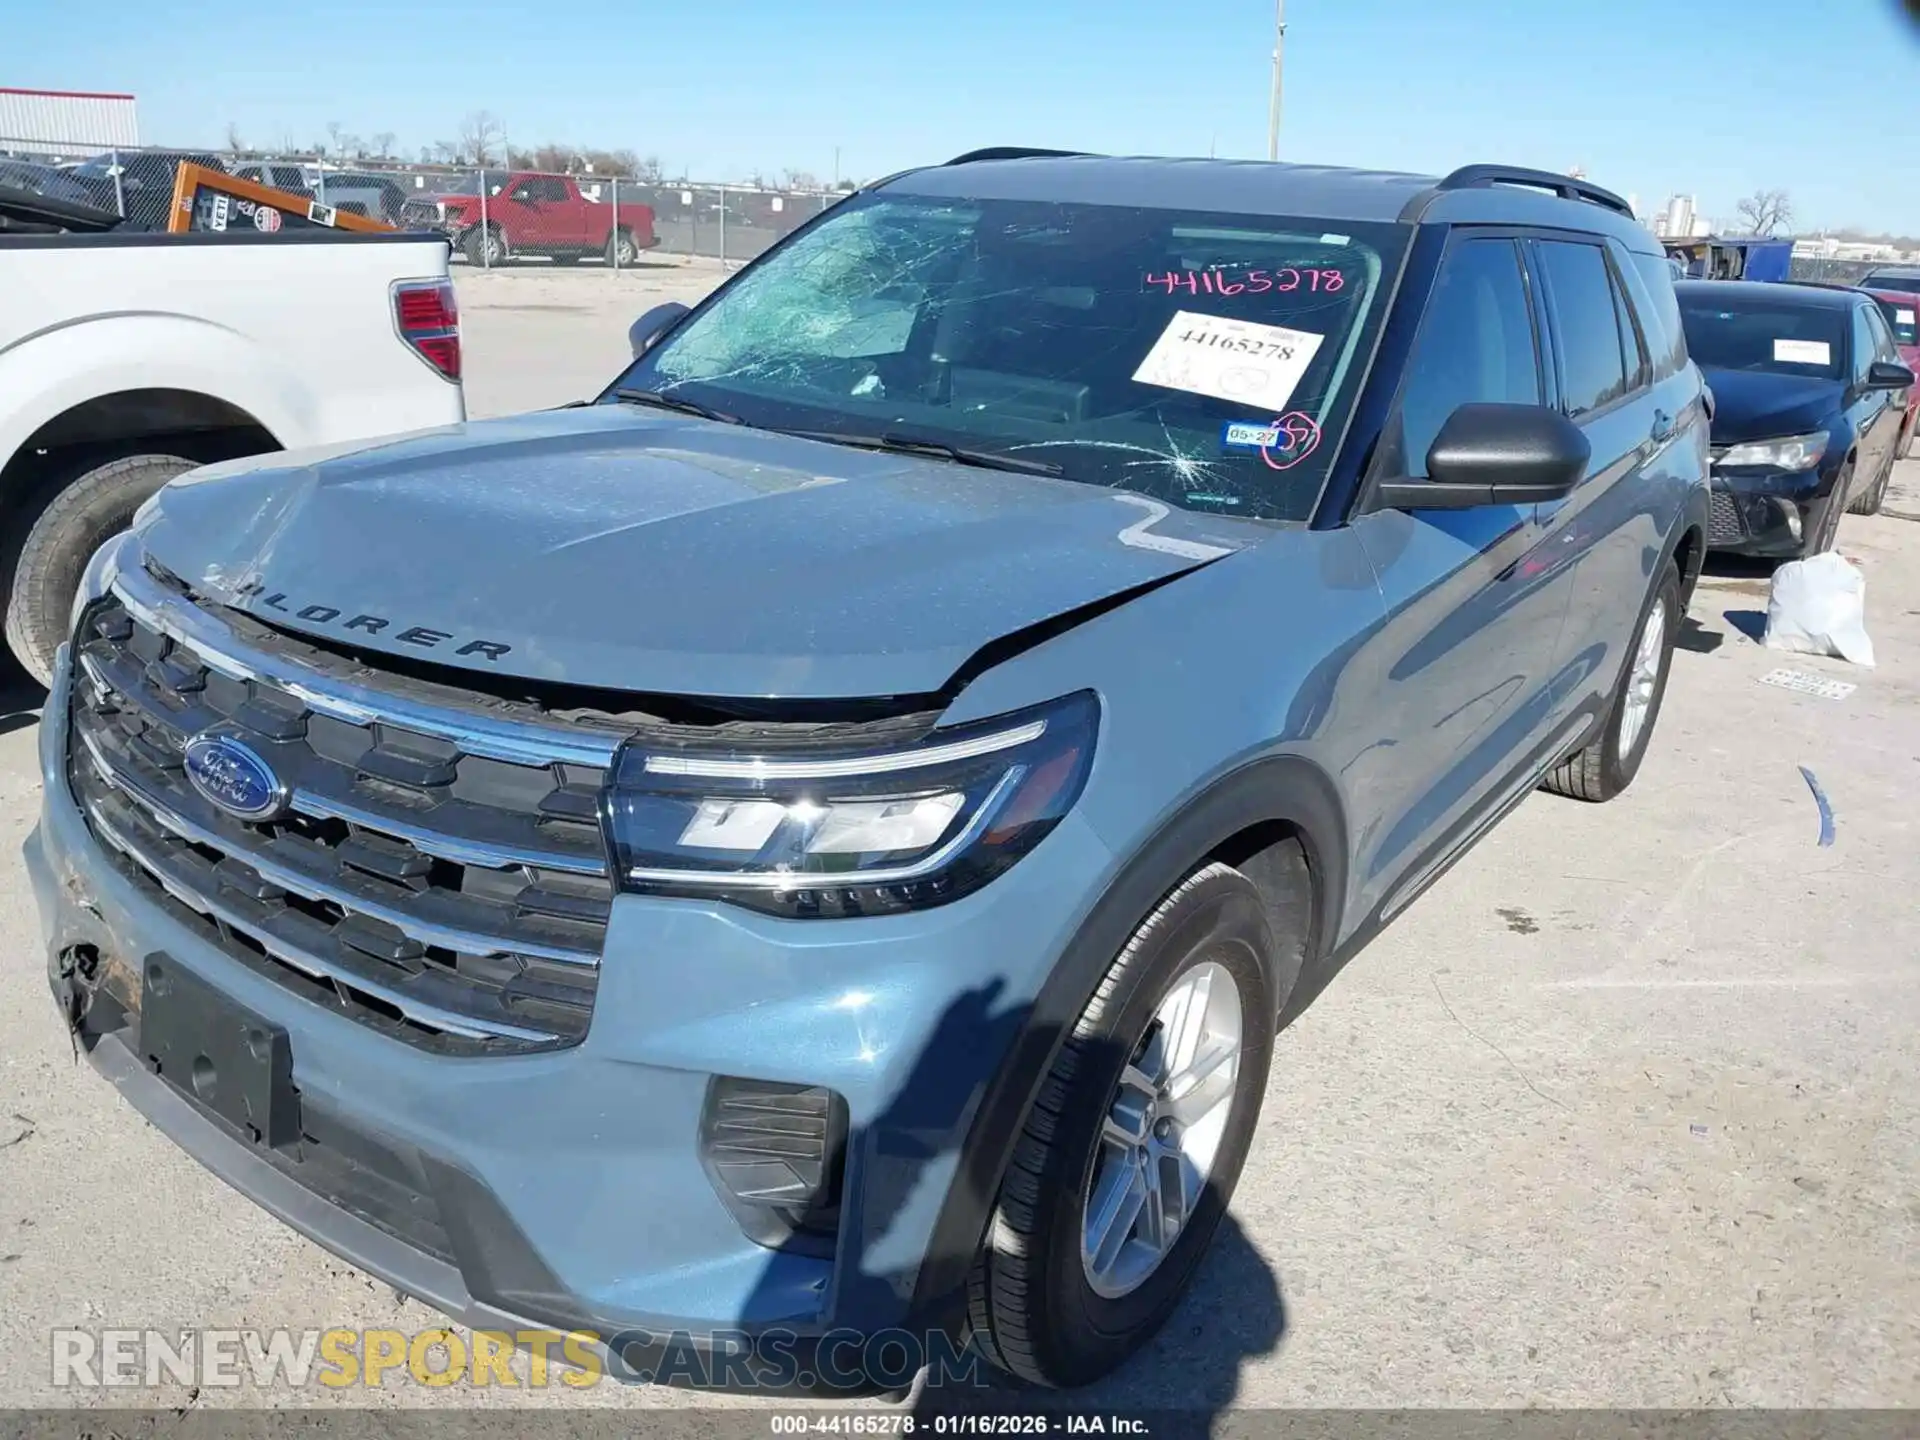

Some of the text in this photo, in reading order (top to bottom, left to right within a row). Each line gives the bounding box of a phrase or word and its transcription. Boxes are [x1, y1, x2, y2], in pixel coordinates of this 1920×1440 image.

[215, 199, 226, 228] YETI
[1147, 268, 1345, 295] 44165278
[1177, 328, 1295, 362] 44165278
